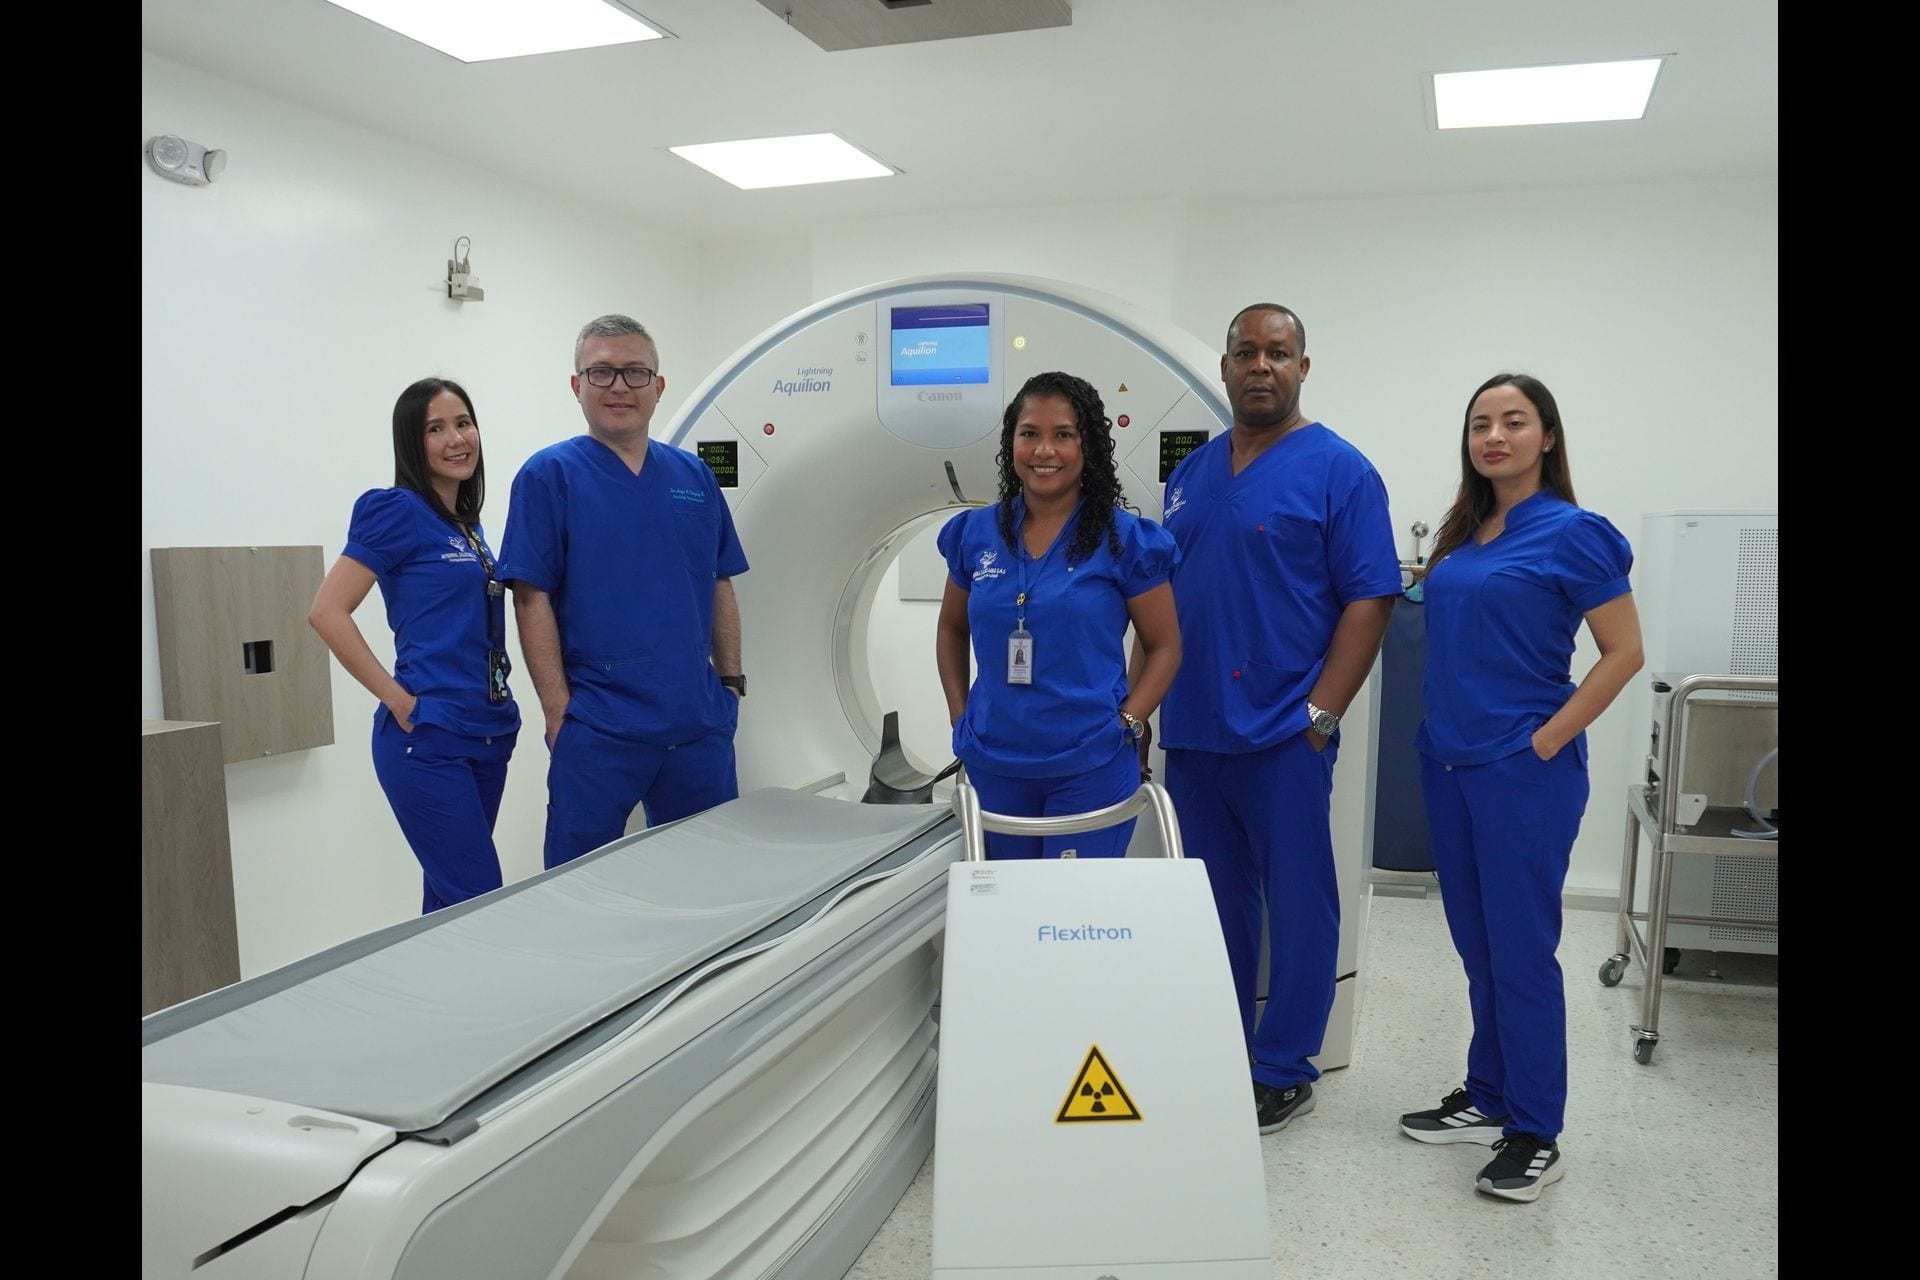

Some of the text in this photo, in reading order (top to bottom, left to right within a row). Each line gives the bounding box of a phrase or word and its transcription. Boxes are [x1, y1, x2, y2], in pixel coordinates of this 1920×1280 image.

[900, 344, 937, 357] Aquilion
[797, 367, 833, 377] Lightning
[773, 378, 831, 397] Aquilion
[917, 391, 962, 401] Canon
[1038, 924, 1132, 941] Flexitron
